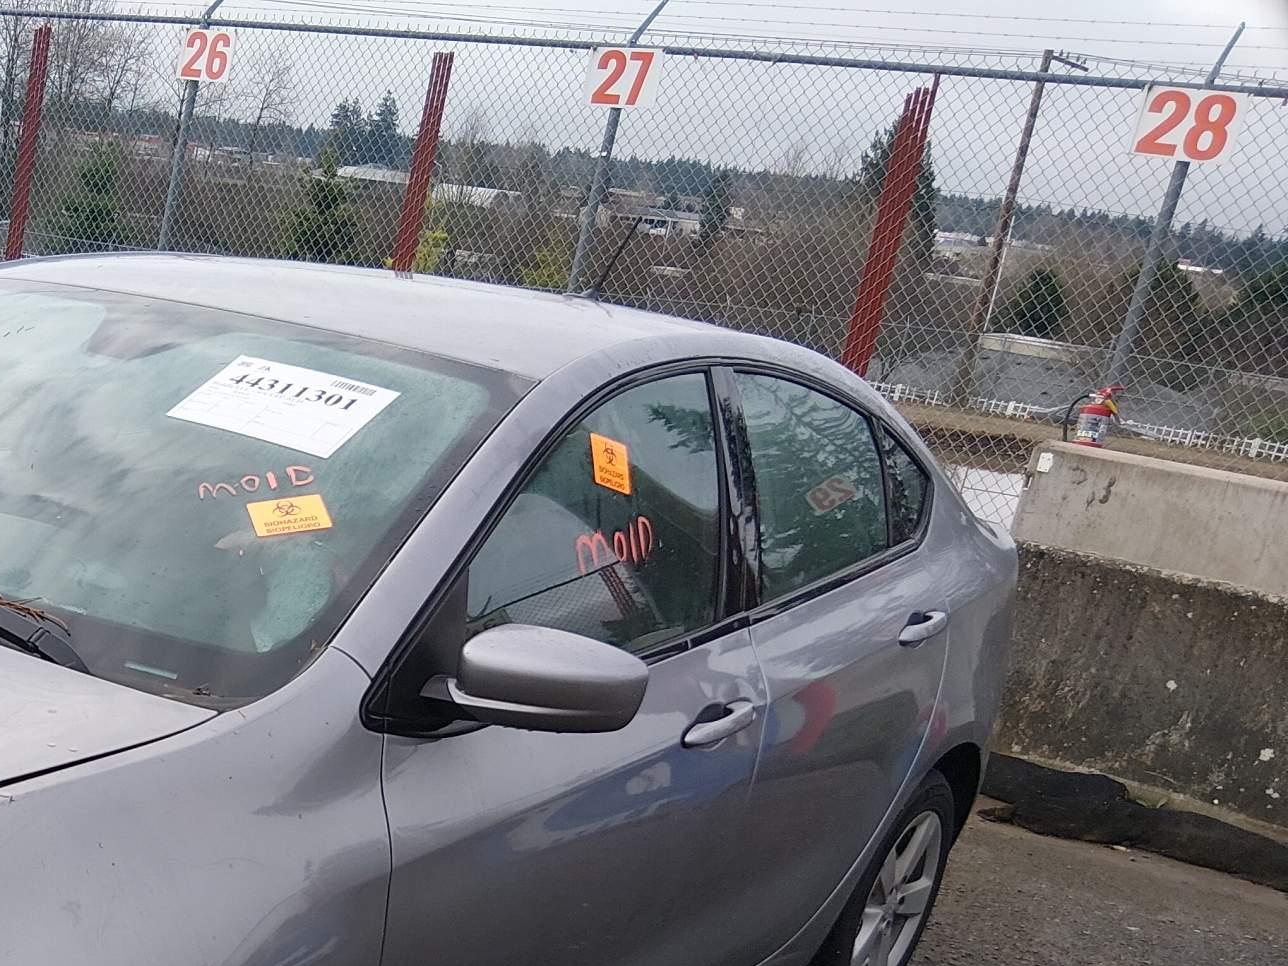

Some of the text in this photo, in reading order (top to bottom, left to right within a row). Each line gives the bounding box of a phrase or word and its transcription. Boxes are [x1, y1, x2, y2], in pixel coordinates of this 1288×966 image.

[180, 31, 231, 81] 26
[590, 49, 655, 106] 27
[1133, 90, 1238, 161] 28
[228, 373, 360, 411] 44311301
[263, 515, 319, 528] BIOHAZARD
